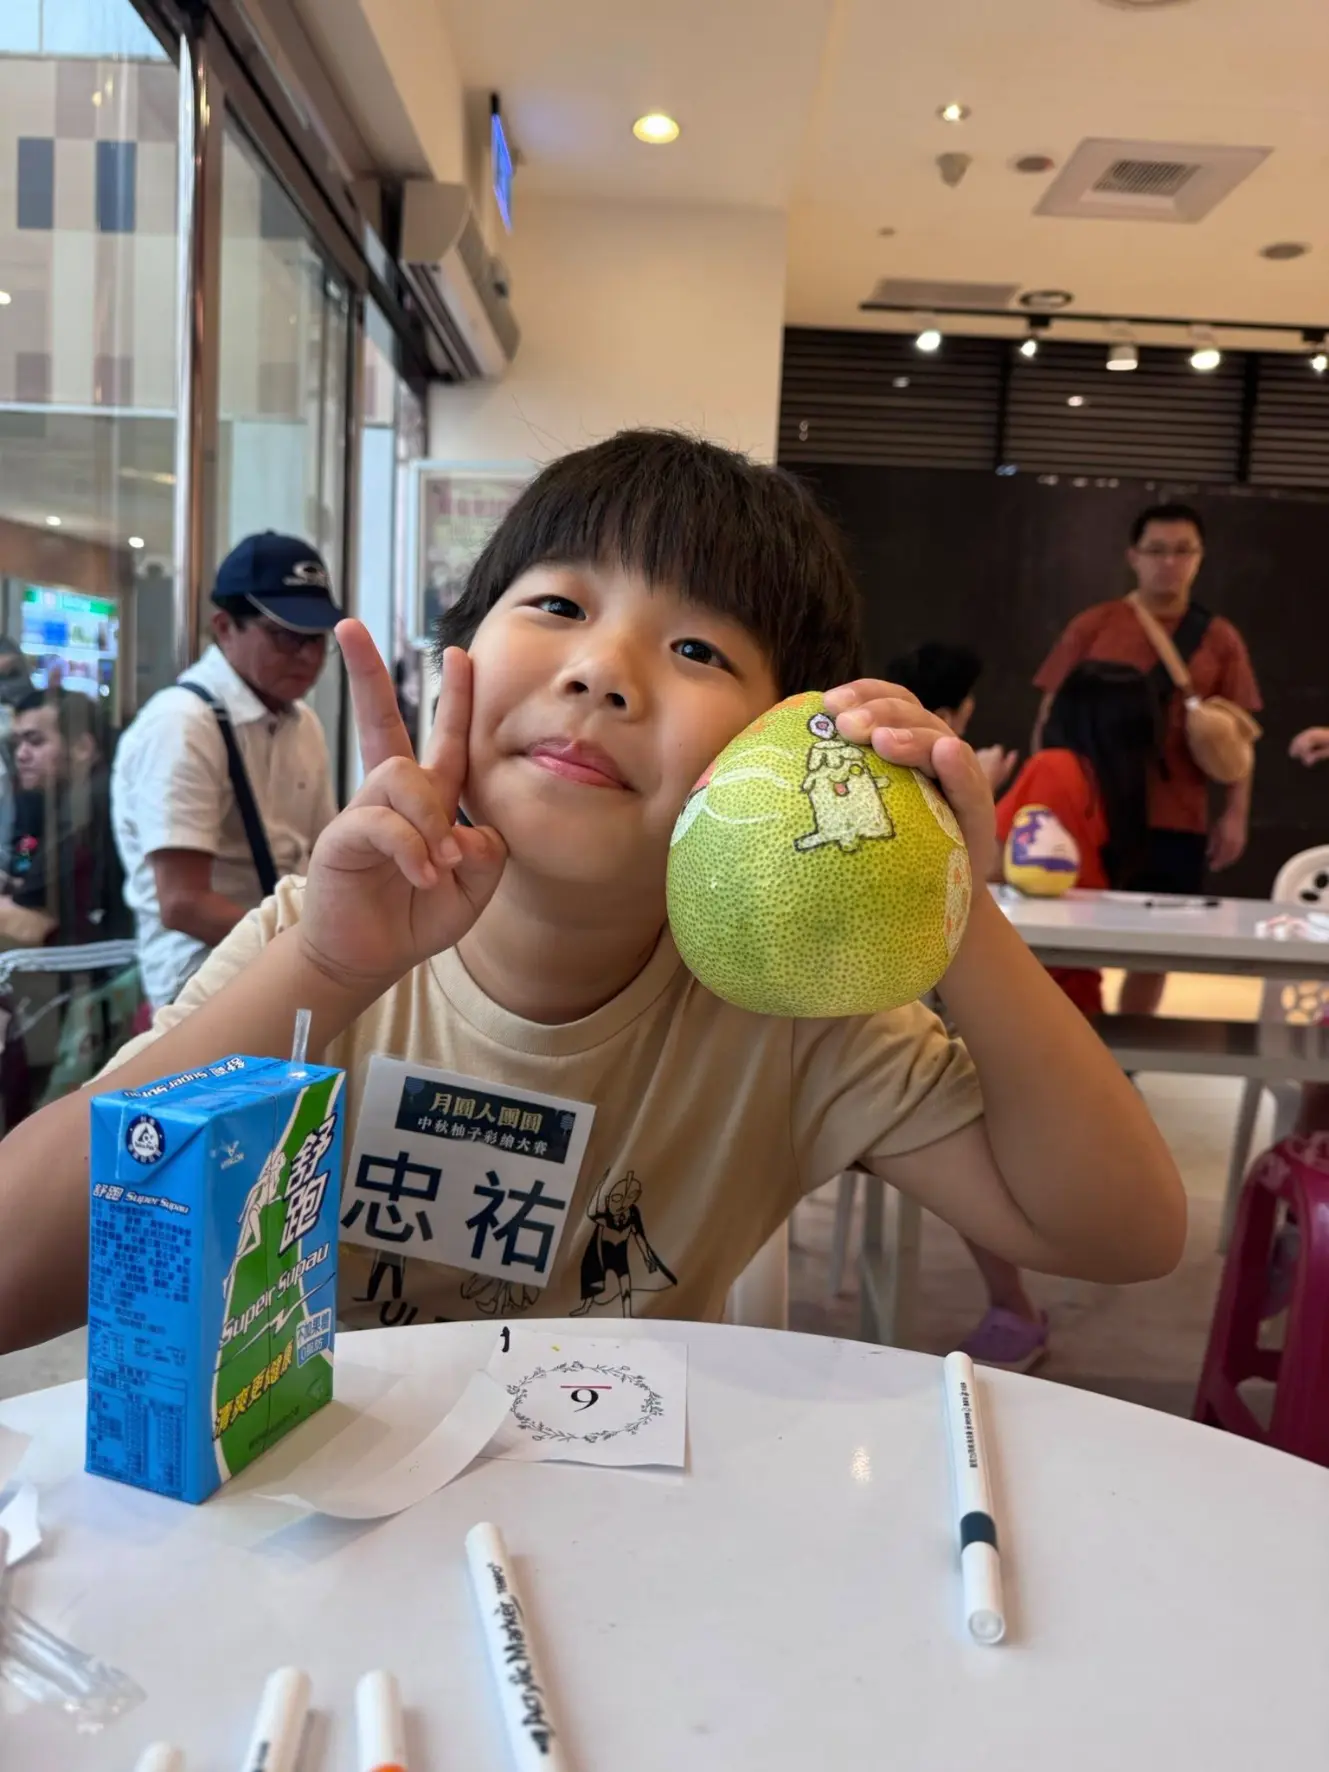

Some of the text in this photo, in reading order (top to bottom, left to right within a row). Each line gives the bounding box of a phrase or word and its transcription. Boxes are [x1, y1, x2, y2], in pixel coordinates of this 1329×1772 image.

[168, 1072, 208, 1090] Super
[417, 1115, 548, 1157] 中秋柚子彩繪大賽
[430, 1092, 543, 1135] 月圓人團圓
[126, 1190, 161, 1206] Super
[159, 1197, 190, 1215] Supau
[279, 1113, 337, 1256] 舒跑
[340, 1151, 566, 1273] 忠祐
[220, 1286, 276, 1348] Super
[277, 1243, 330, 1298] Supau
[498, 1600, 529, 1664] Marker
